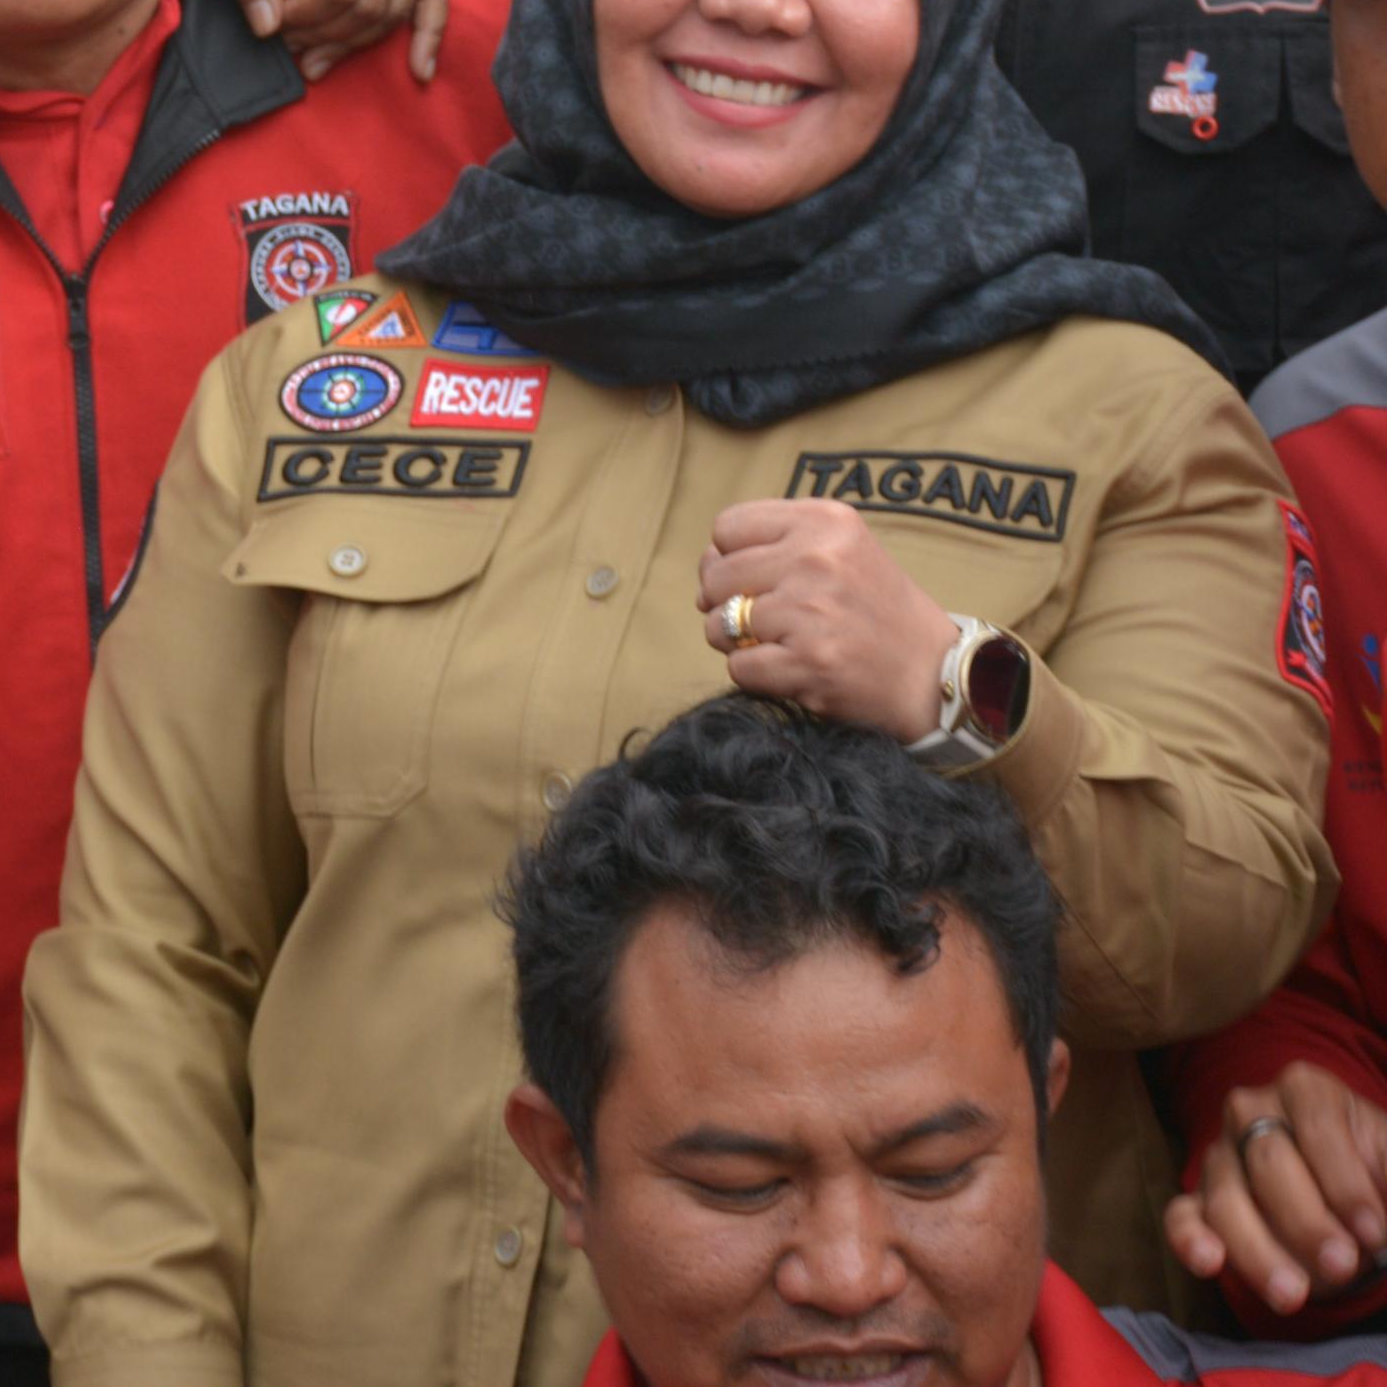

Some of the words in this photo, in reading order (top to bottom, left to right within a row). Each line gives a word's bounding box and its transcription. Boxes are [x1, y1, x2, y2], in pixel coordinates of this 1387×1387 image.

[239, 191, 350, 221] TAGANA
[421, 371, 540, 419] RESCUE
[282, 444, 505, 488] CECE
[808, 458, 1054, 529] TAGANA
